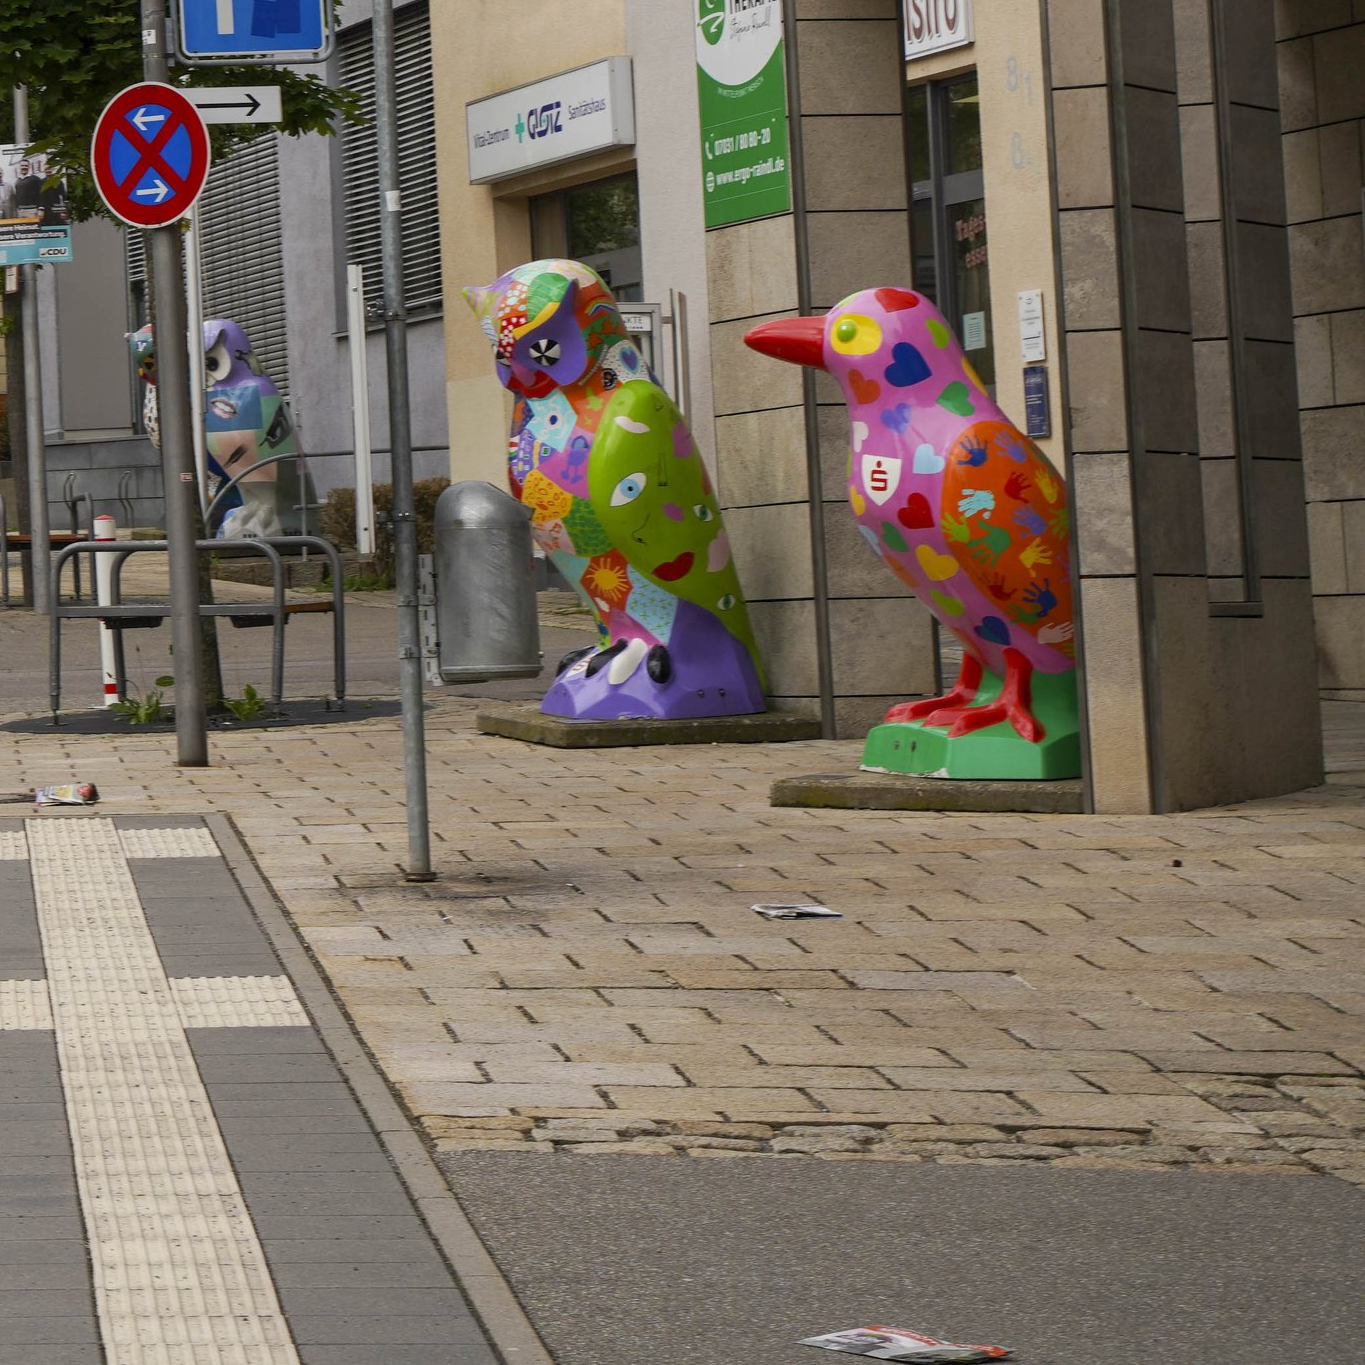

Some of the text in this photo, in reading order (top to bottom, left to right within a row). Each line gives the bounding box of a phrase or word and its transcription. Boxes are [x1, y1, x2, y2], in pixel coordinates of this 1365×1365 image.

[473, 128, 510, 148] Vital-Zentrum
[568, 98, 606, 121] Sanitätshaus
[47, 248, 67, 256] CDU
